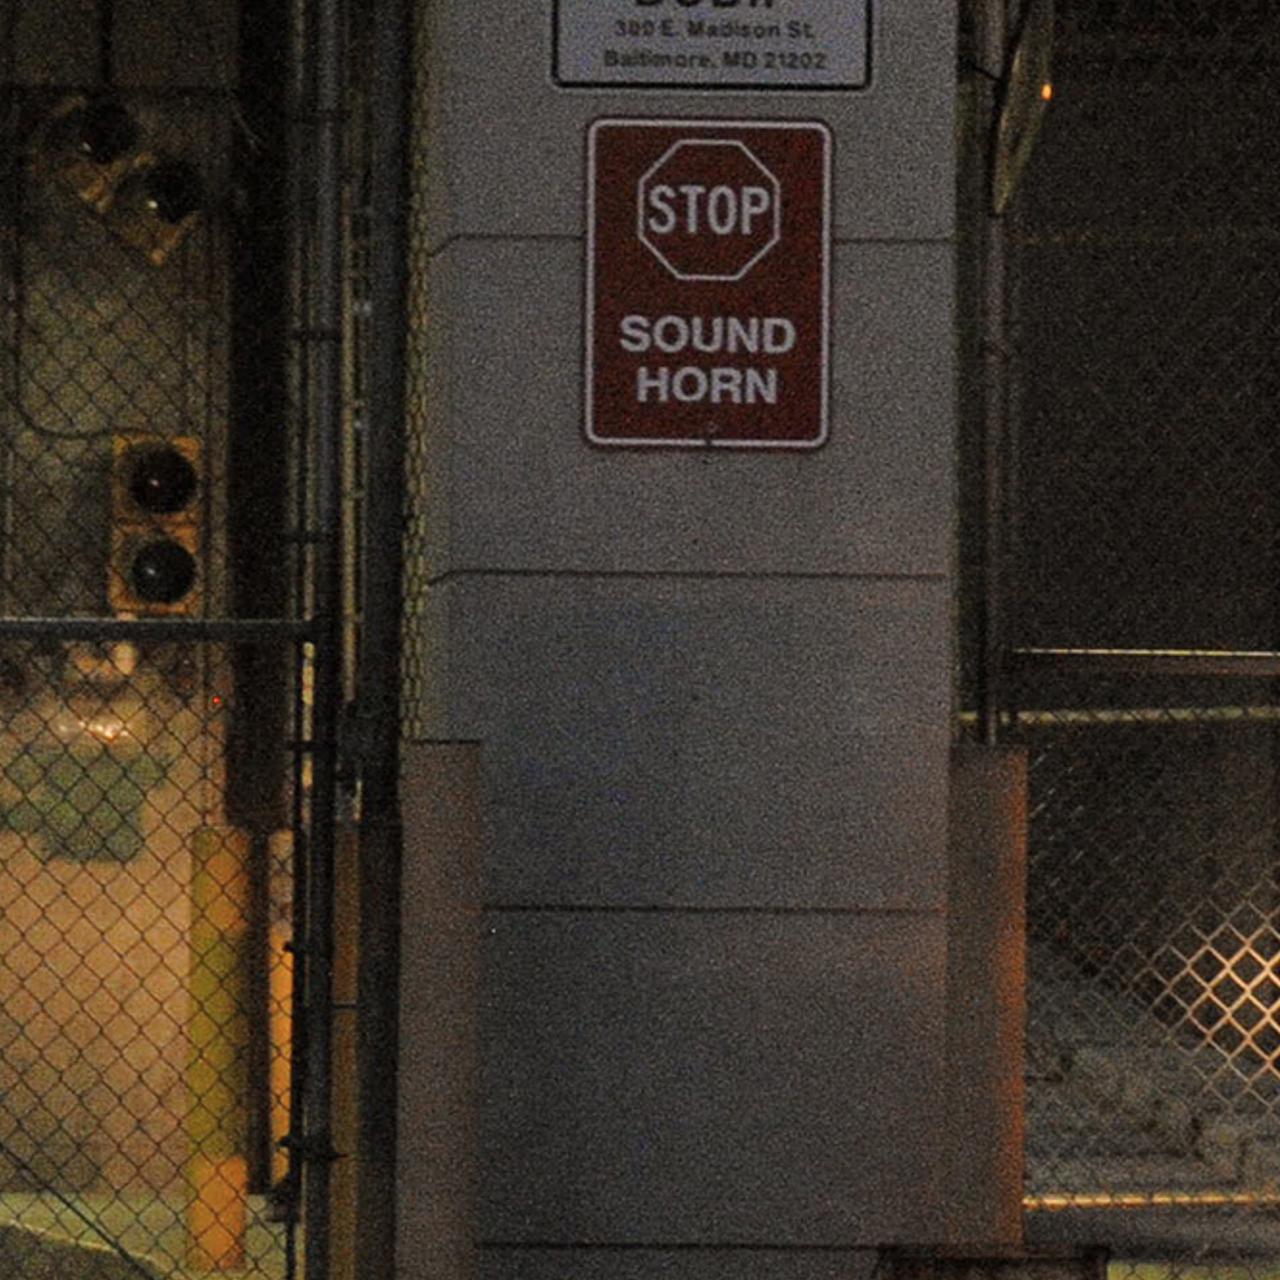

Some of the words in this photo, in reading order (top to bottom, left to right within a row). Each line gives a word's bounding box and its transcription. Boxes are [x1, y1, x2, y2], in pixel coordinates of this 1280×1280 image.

[687, 20, 781, 39] Madison
[723, 51, 758, 69] MD
[764, 52, 828, 70] 21202
[648, 185, 771, 235] STOP
[619, 315, 797, 354] SOUND
[636, 367, 777, 404] HORN
